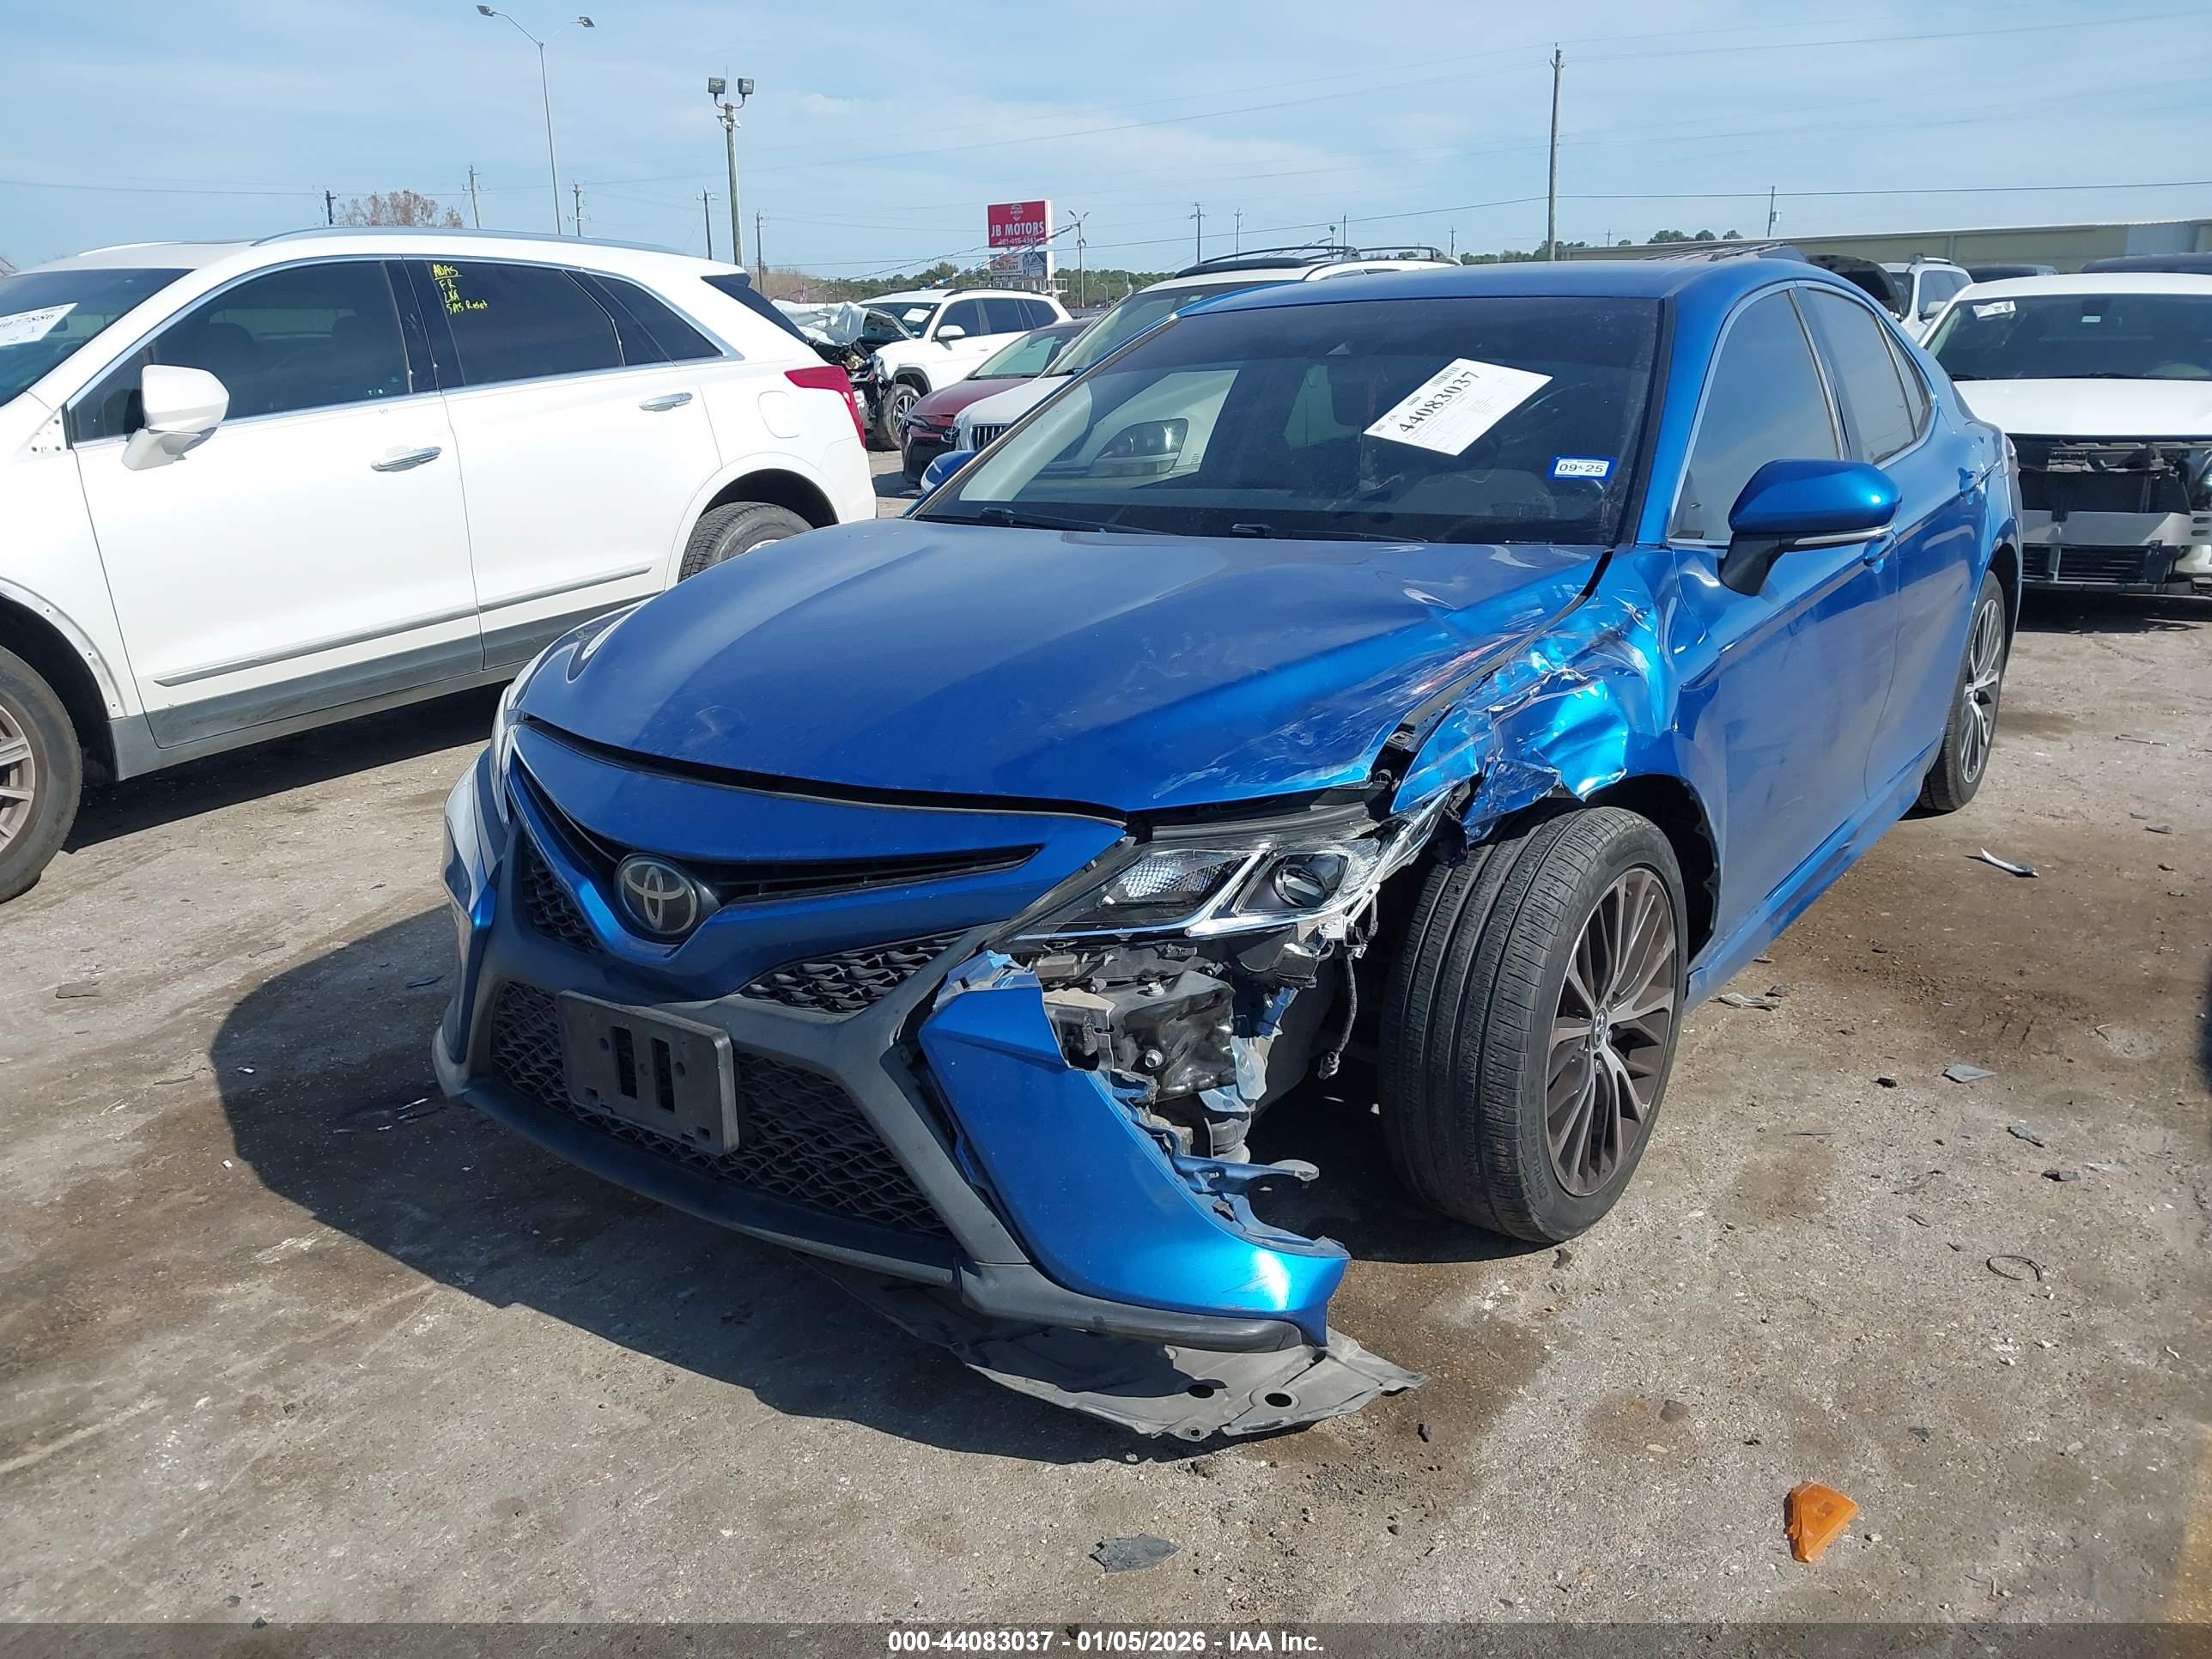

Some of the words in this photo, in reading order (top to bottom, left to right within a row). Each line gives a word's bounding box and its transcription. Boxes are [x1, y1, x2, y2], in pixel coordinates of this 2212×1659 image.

[991, 224, 1002, 237] JB
[1005, 221, 1044, 236] MOTORS
[433, 264, 459, 277] ADAS
[1399, 371, 1480, 433] 44083037
